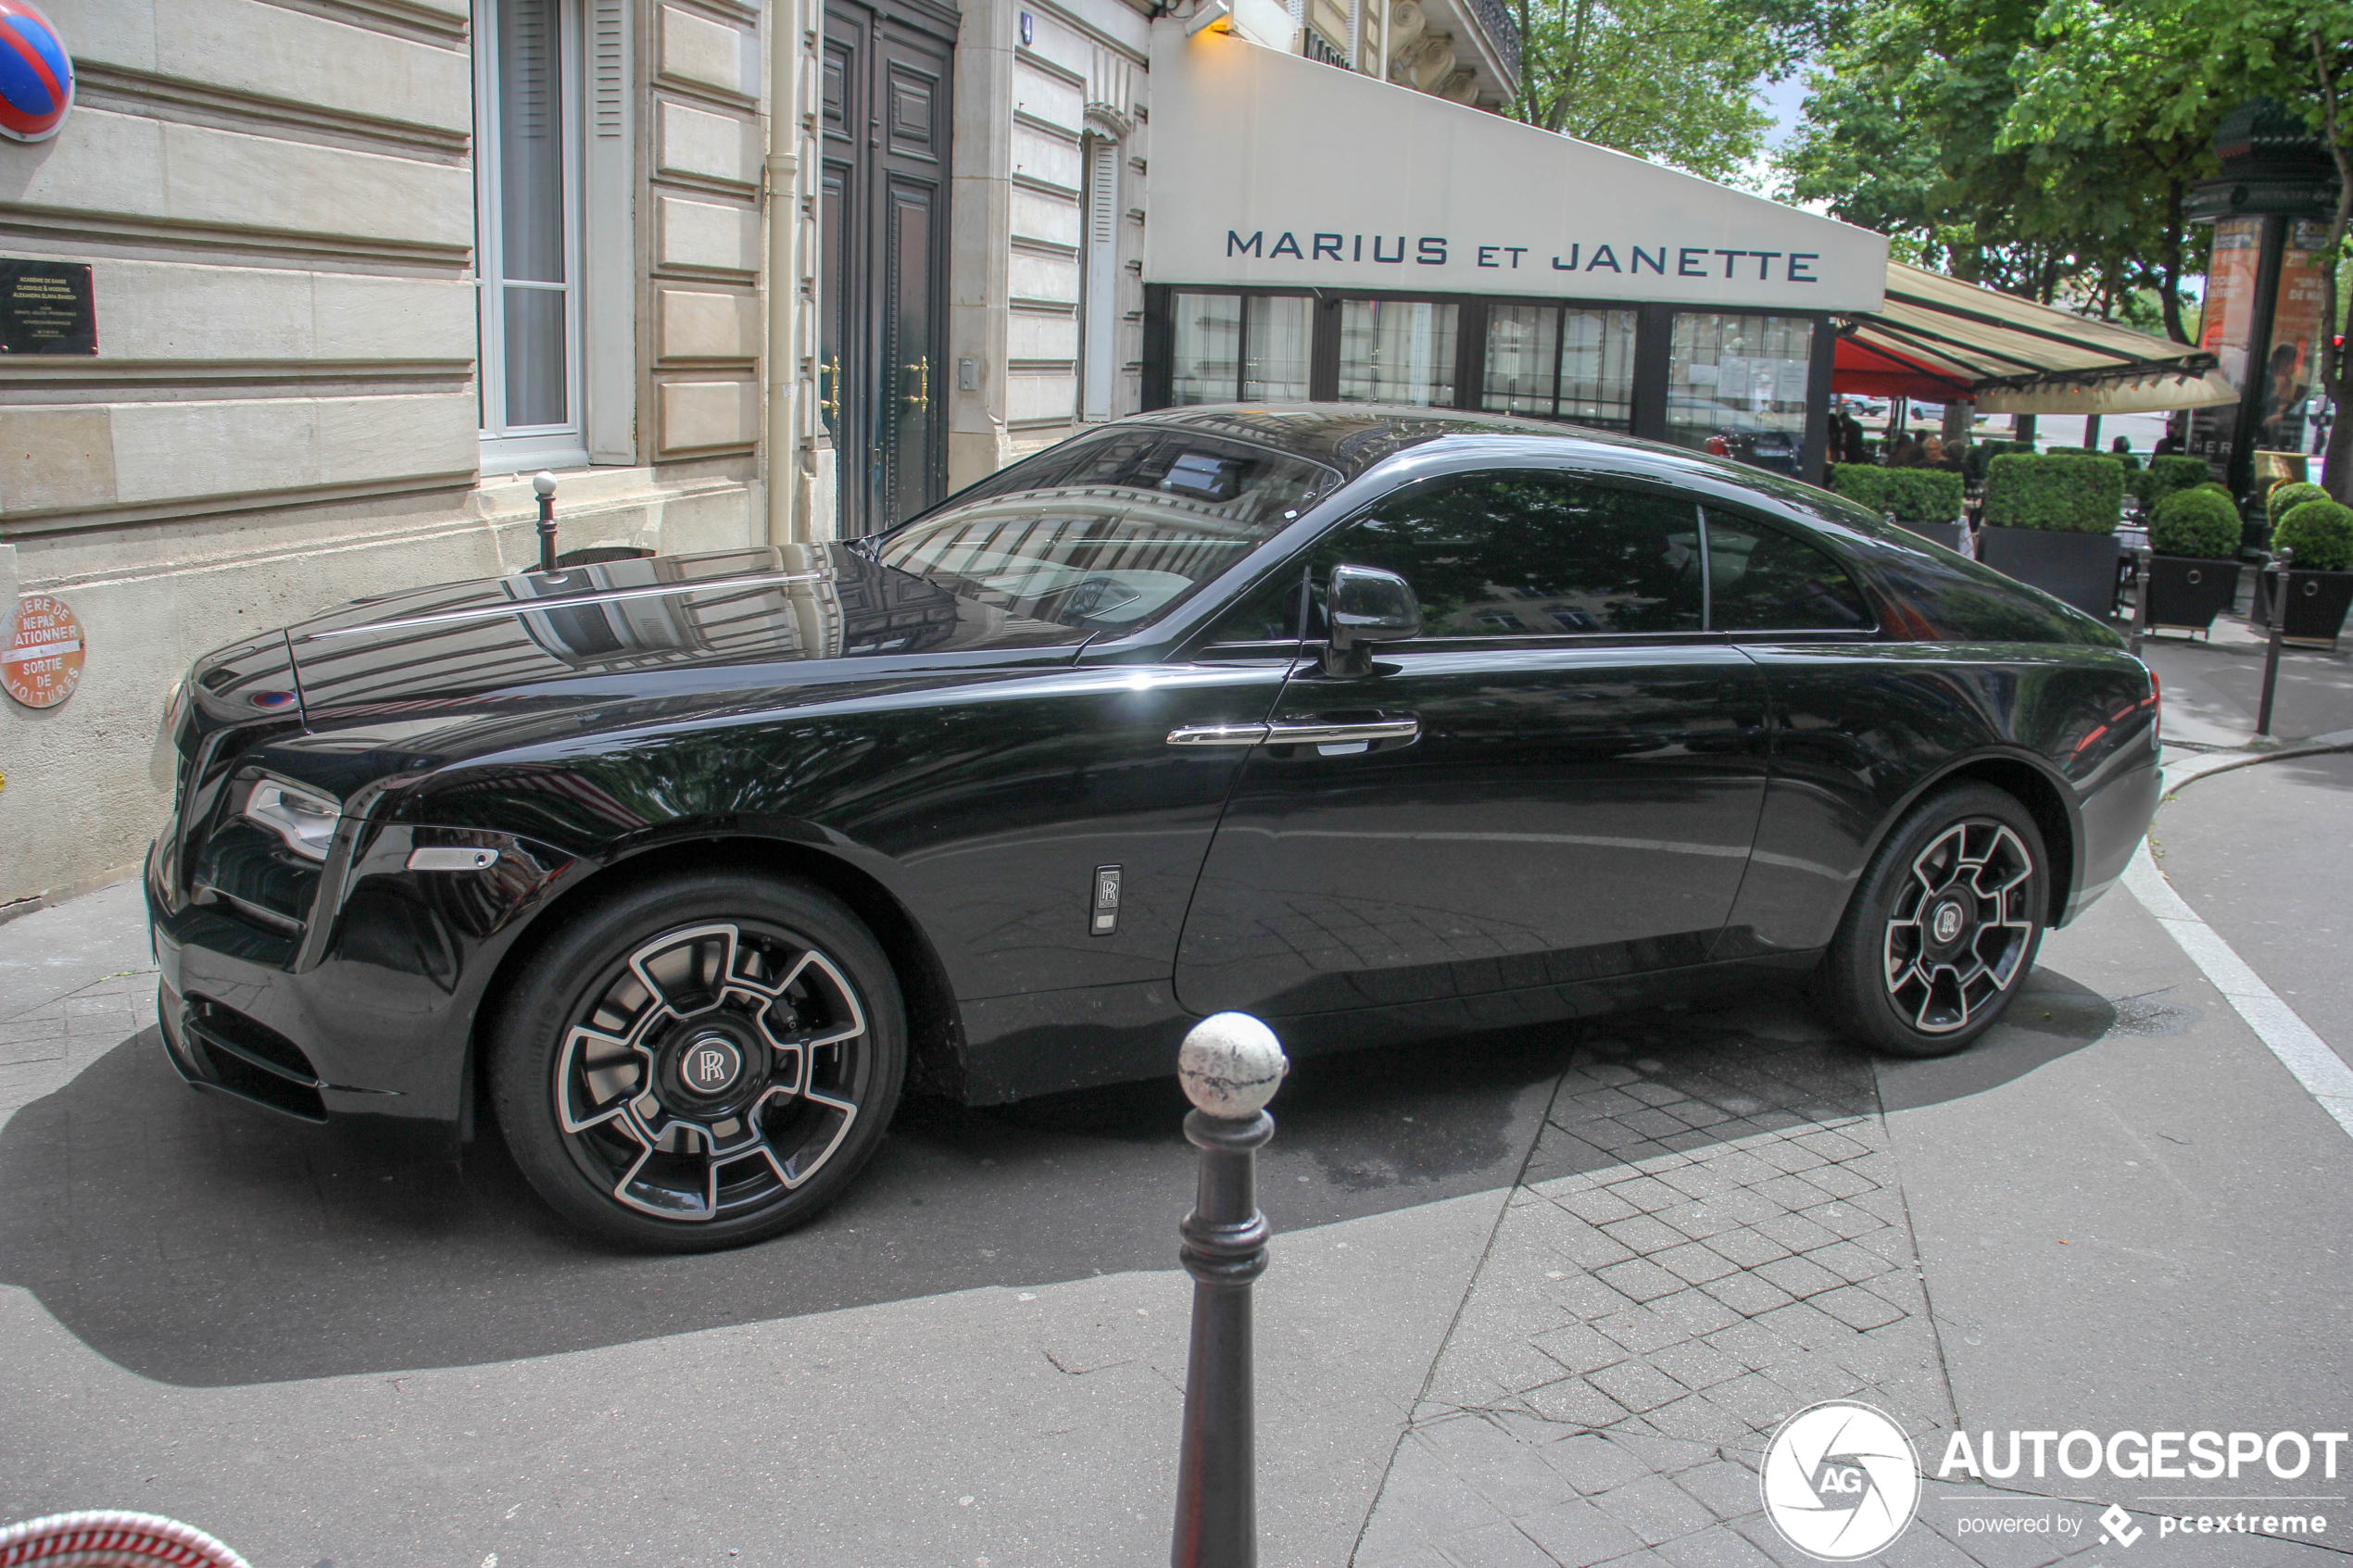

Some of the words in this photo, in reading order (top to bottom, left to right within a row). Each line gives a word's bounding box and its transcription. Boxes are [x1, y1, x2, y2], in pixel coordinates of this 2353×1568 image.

[1025, 17, 1031, 40] 4
[1227, 230, 1447, 266] MARIUS
[1478, 245, 1529, 269] ET
[1552, 244, 1819, 282] JANETTE
[53, 604, 69, 621] DE
[22, 616, 36, 630] NE
[37, 614, 55, 629] PAS
[22, 658, 63, 676] SORTIE
[11, 667, 79, 703] VOITURES
[36, 673, 52, 688] DE
